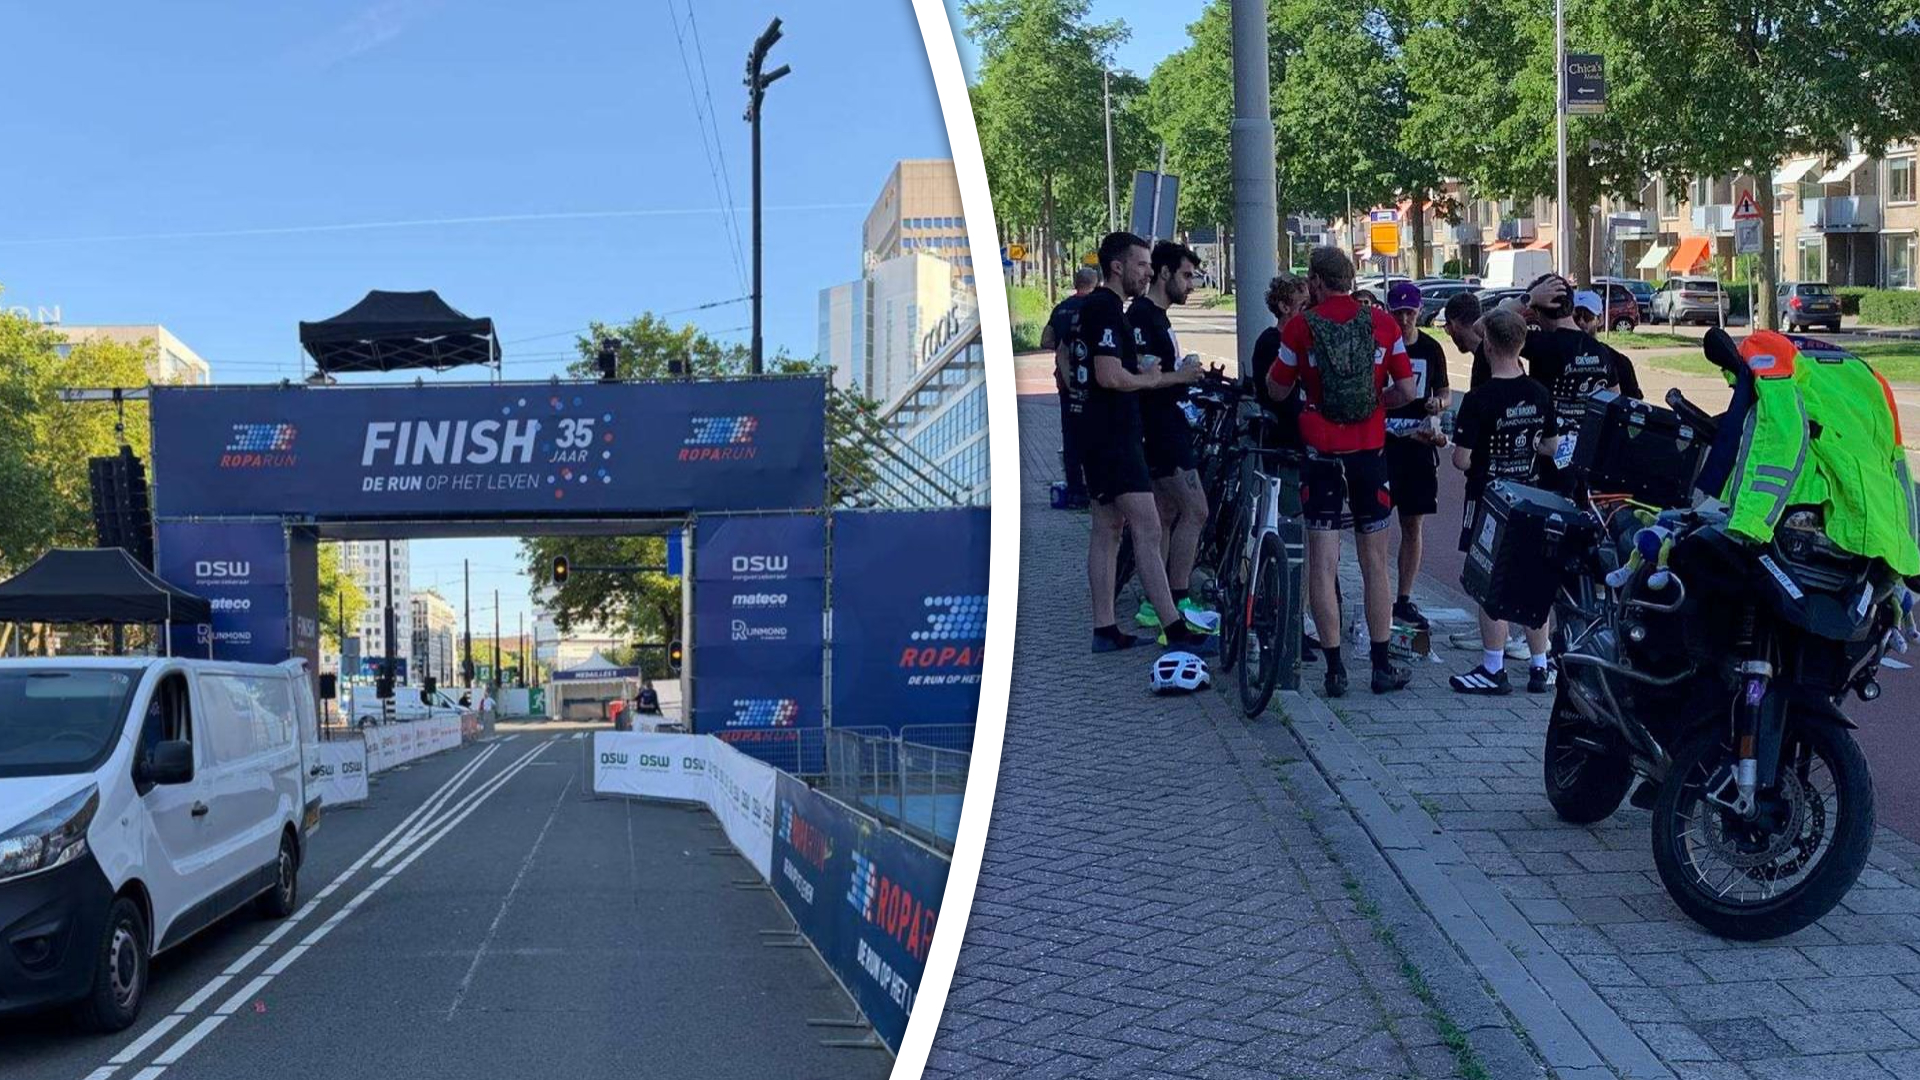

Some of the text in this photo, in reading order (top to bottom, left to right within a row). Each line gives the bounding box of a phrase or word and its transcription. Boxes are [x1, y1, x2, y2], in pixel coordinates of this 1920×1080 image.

[1568, 61, 1603, 75] Chica's
[361, 418, 595, 467] FINISH 35
[220, 454, 298, 468] ROPARUN
[549, 449, 589, 463] JAAR
[678, 447, 757, 461] ROPARUN
[362, 473, 541, 492] DE RUN OP HET LEVEN
[195, 561, 250, 577] DSW
[732, 555, 788, 572] DSW
[210, 598, 251, 610] ateco
[732, 592, 788, 605] mateco
[908, 674, 982, 685] DE RUN OP HET
[601, 753, 628, 764] DSW
[640, 755, 670, 767] DSW
[342, 762, 362, 773] DSW
[857, 938, 868, 965] DE
[865, 949, 881, 981] RUN
[879, 961, 892, 990] OP
[889, 971, 909, 1009] HET
